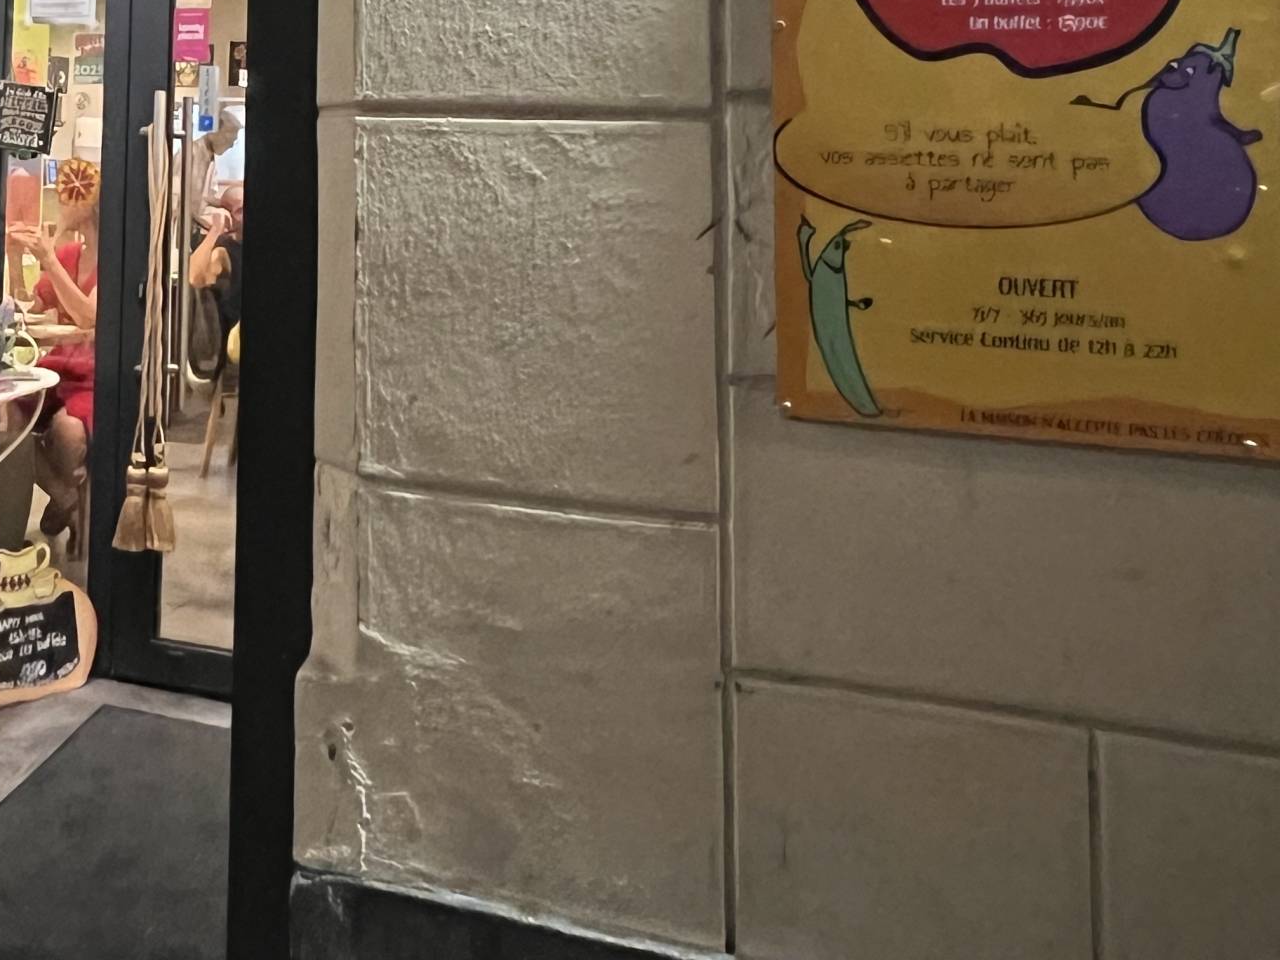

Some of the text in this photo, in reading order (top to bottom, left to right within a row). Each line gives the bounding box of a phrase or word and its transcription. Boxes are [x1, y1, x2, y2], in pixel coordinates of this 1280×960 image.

[993, 14, 1042, 30] buffet
[924, 125, 974, 142] vous
[998, 276, 1079, 299] OUVERT
[909, 327, 974, 346] Service
[1058, 334, 1080, 354] de
